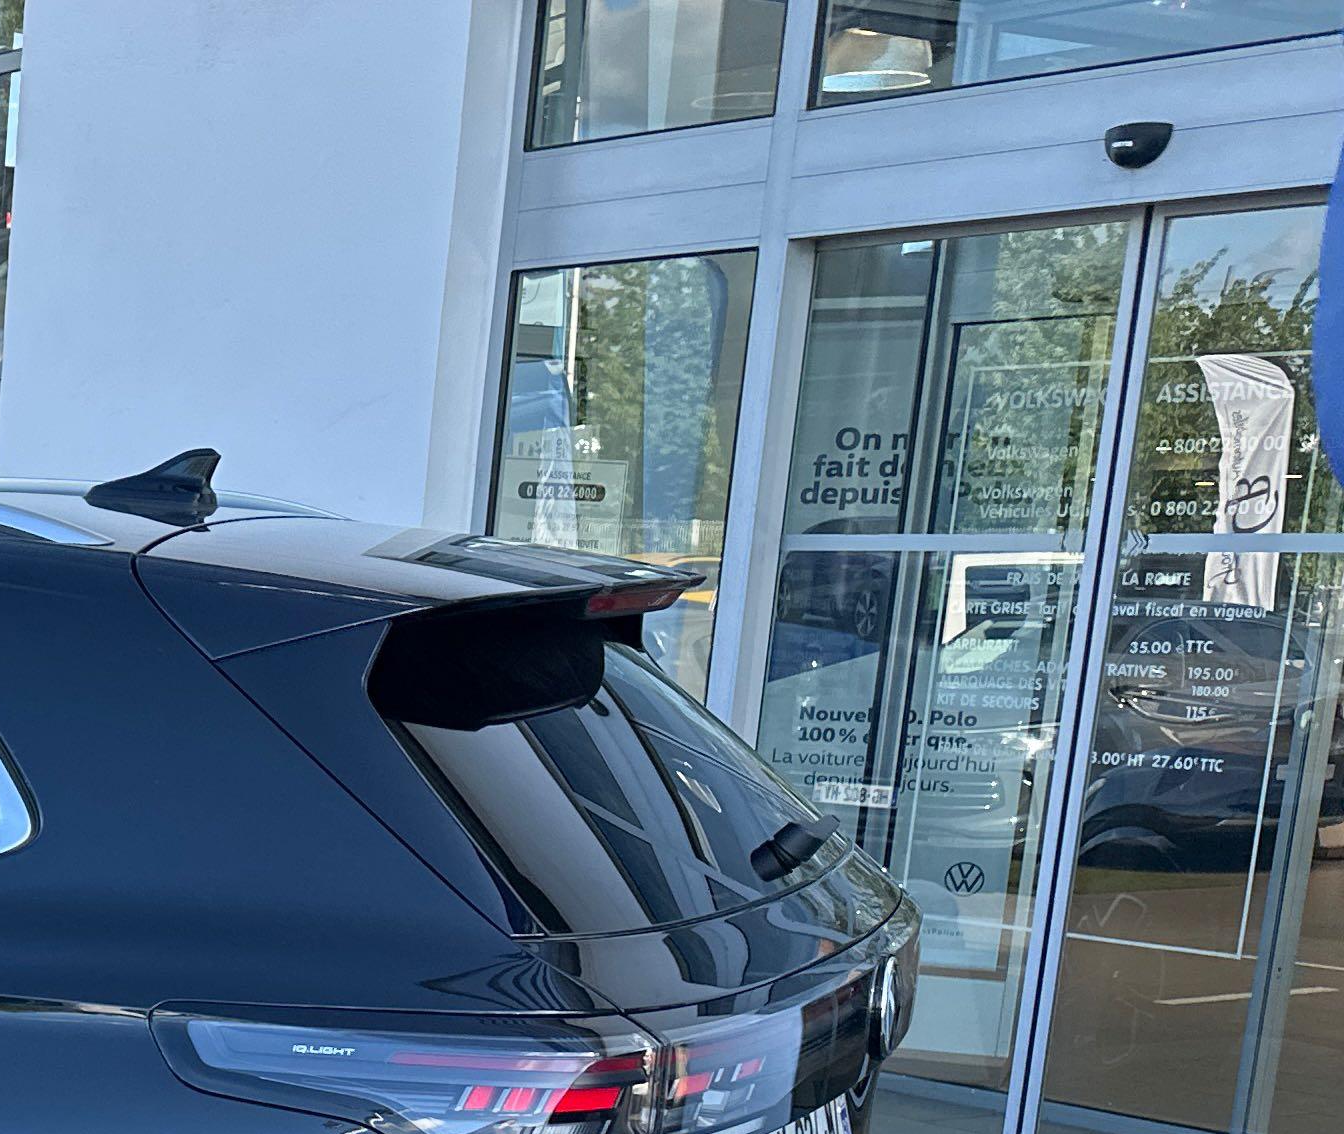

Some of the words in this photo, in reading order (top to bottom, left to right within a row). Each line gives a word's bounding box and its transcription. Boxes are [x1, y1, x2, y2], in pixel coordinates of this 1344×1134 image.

[1156, 381, 1295, 403] ASSISTANCE
[835, 427, 881, 451] On
[1174, 438, 1209, 454] 800
[812, 454, 868, 478] fait
[558, 487, 569, 498] 22
[800, 480, 902, 510] depuis
[1151, 501, 1160, 516] 0
[1165, 501, 1196, 516] 800
[1006, 572, 1040, 586] FRAIS
[1047, 572, 1063, 586] DE
[1122, 569, 1139, 587] LA
[1144, 571, 1192, 588] ROUTE
[991, 601, 1030, 615] GRISE
[1145, 602, 1185, 617] fiscal
[1189, 606, 1207, 618] en
[1129, 640, 1171, 654] 35.00
[1186, 640, 1214, 654] TTC
[937, 692, 955, 706] KIT
[960, 693, 977, 707] DE
[982, 694, 1039, 711] SECOURS
[799, 705, 873, 723] Nouvel
[930, 710, 977, 728] Polo
[797, 727, 835, 743] 100
[839, 728, 856, 744] %
[772, 748, 793, 765] La
[798, 750, 864, 767] voiture
[1127, 753, 1145, 767] HT
[1195, 757, 1224, 773] TTC
[292, 1044, 356, 1056] IQ.LIGHT
